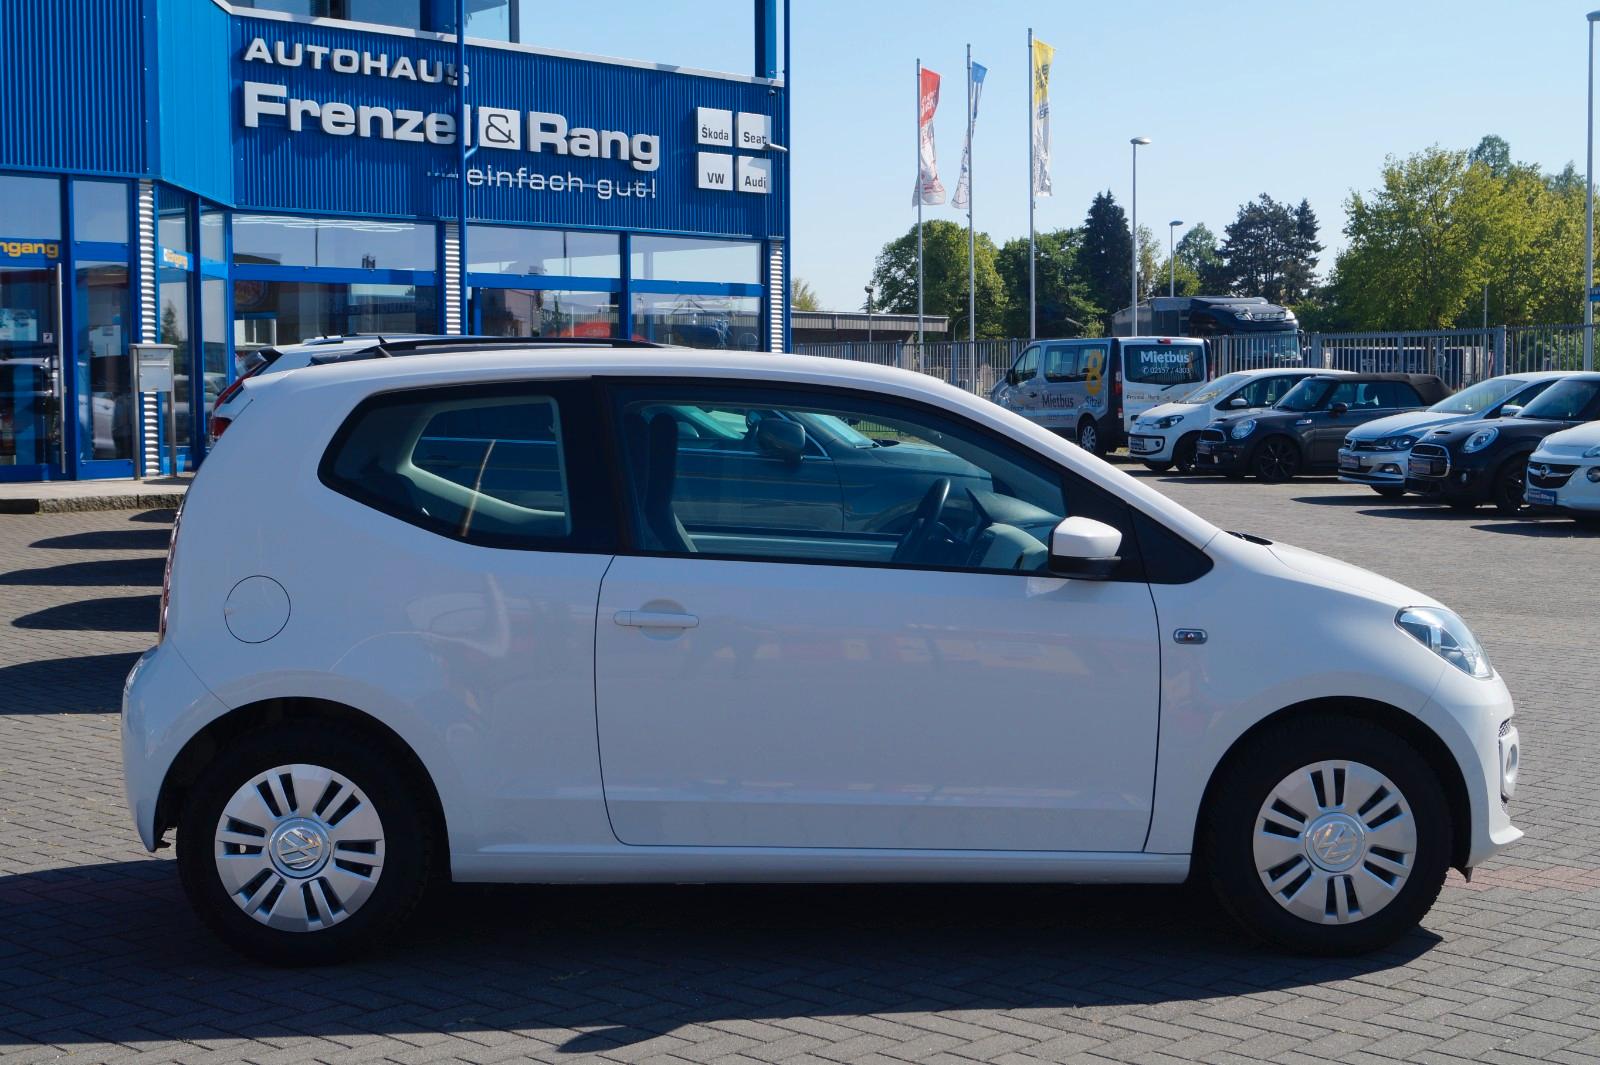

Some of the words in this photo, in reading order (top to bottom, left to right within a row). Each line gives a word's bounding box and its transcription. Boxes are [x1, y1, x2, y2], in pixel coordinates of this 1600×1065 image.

[244, 37, 470, 87] AUTOHAUS
[701, 124, 730, 141] Škoda
[743, 131, 768, 145] Seat
[526, 111, 661, 172] Rang
[466, 164, 583, 193] einfach
[596, 178, 657, 200] gut!
[706, 172, 725, 185] VW
[744, 175, 767, 189] Audi
[1140, 350, 1191, 364] Mietbus
[1042, 393, 1074, 408] Mietbus
